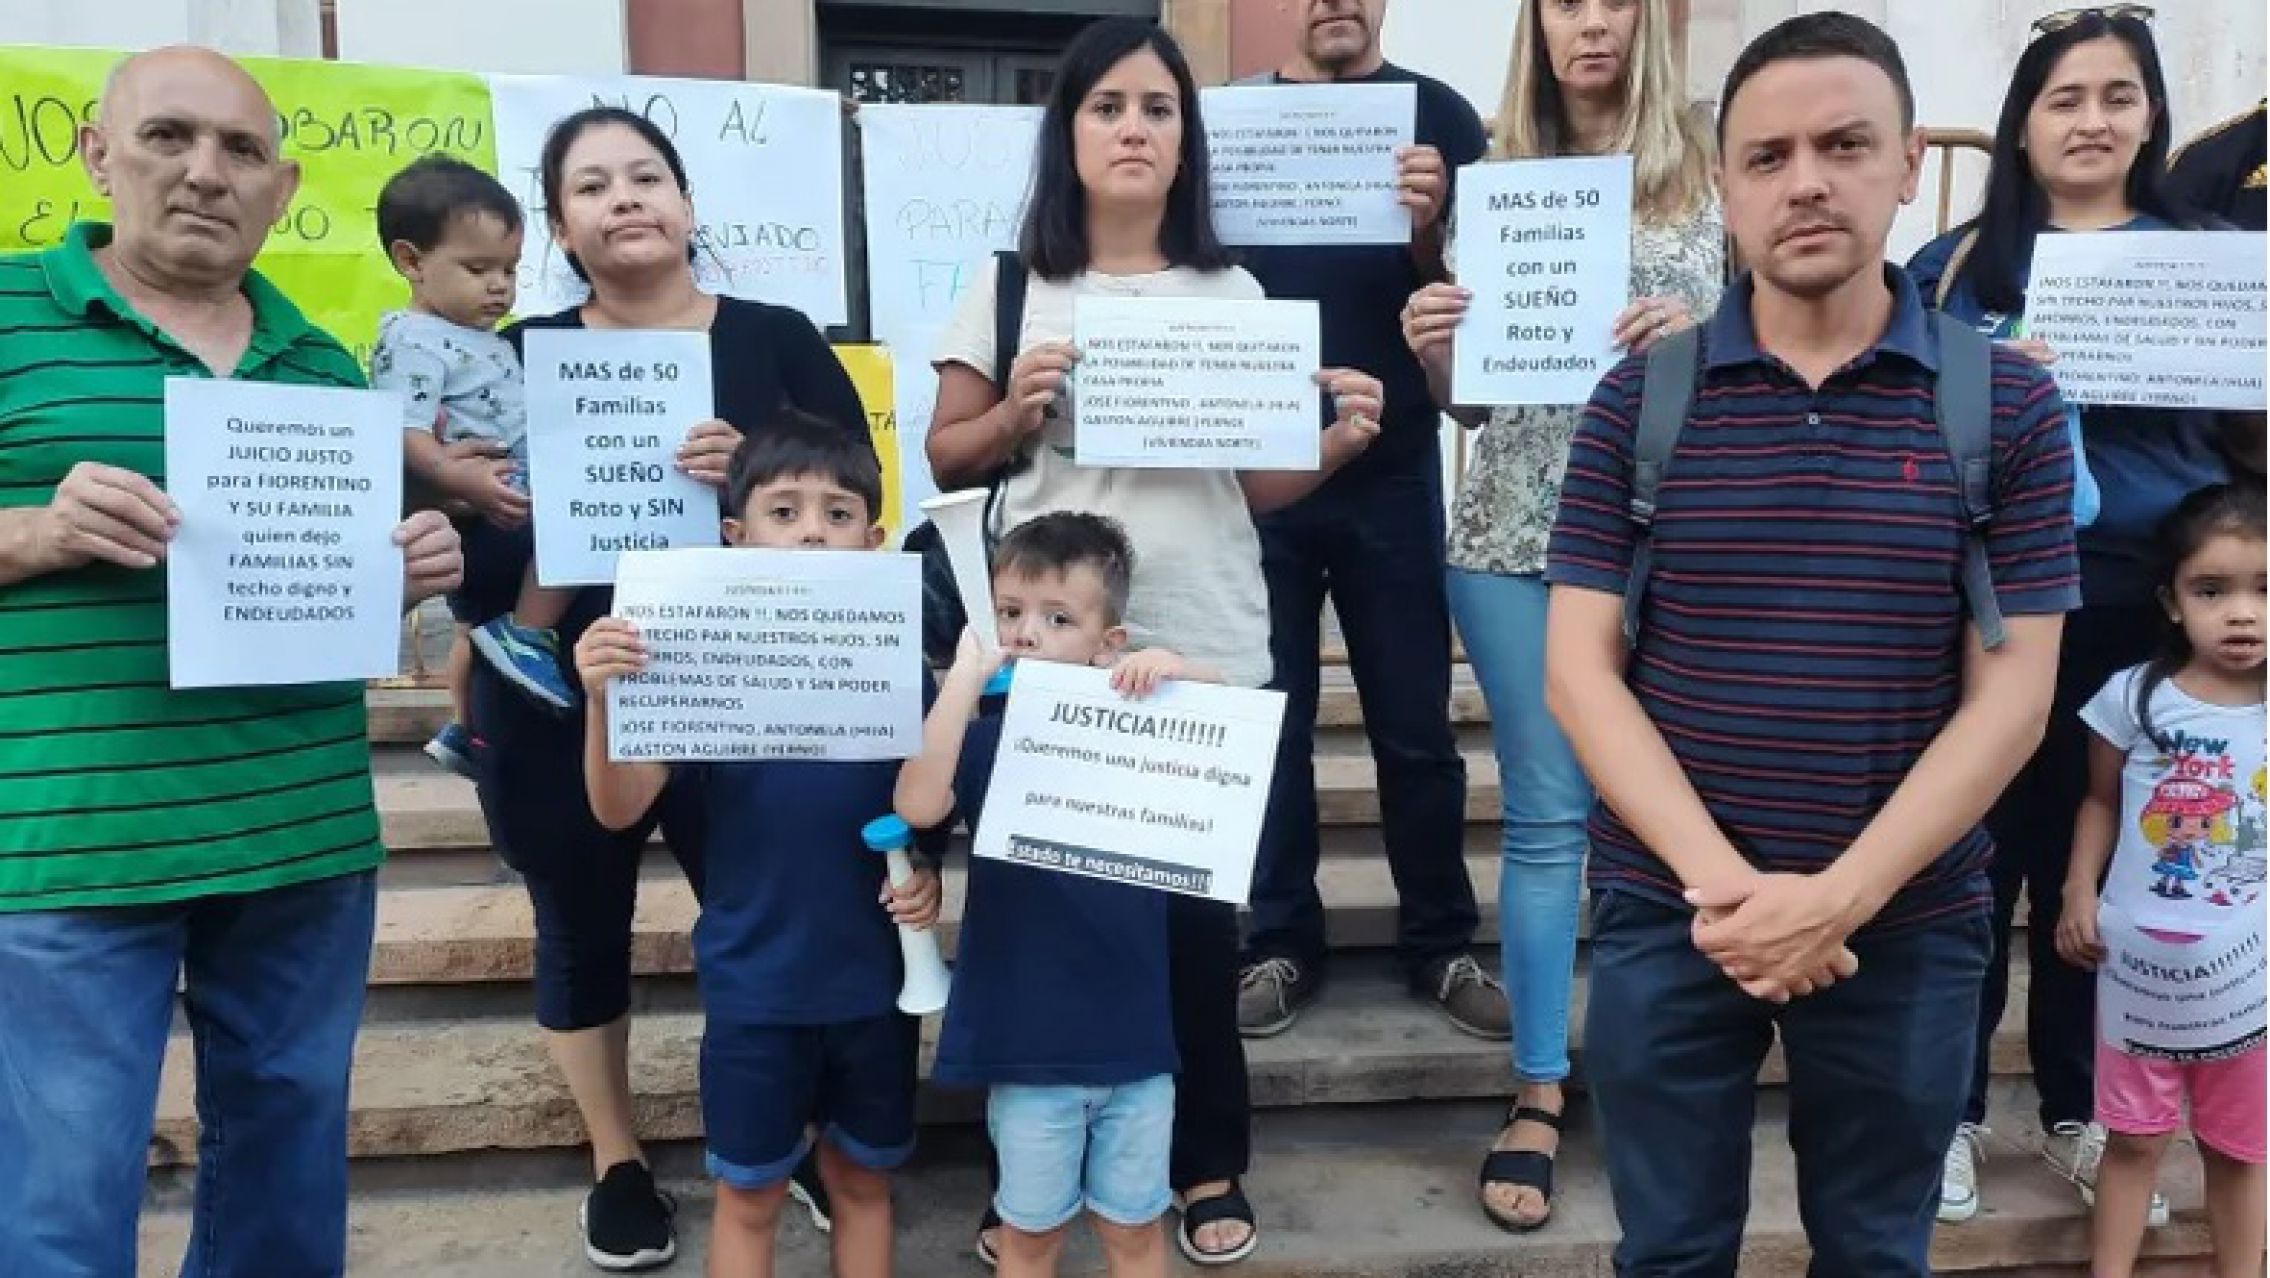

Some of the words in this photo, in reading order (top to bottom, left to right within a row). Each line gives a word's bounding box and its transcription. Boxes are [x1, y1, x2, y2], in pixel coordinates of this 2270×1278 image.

[1488, 190, 1536, 211] MAS
[1541, 190, 1568, 208] de
[1575, 188, 1600, 207] 50
[896, 197, 1012, 241] PARA
[1500, 222, 1585, 243] Familias
[1506, 262, 1544, 277] con
[1550, 261, 1577, 275] un
[1504, 285, 1577, 309] SUEÑO
[1506, 325, 1556, 341] Roto
[1562, 327, 1573, 343] y
[559, 361, 612, 381] MAS
[619, 361, 645, 381] de
[653, 362, 679, 381] 50
[1483, 355, 1597, 372] Endeudados
[575, 395, 666, 415] Familias
[227, 417, 326, 437] Queremos
[328, 426, 355, 437] un
[585, 435, 625, 448] con
[633, 435, 660, 448] un
[227, 446, 291, 462] JUICIO
[296, 449, 353, 465] JUSTO
[585, 461, 664, 483] SUEÑO
[207, 476, 251, 490] para
[258, 474, 372, 492] FIORENTINO
[229, 500, 240, 514] Y
[246, 501, 272, 516] SU
[278, 501, 353, 517] FAMILIA
[570, 499, 623, 517] Roto
[628, 503, 643, 520] y
[648, 498, 684, 517] SIN
[242, 529, 297, 544] quien
[300, 529, 341, 546] dejo
[590, 533, 669, 551] Justicia
[229, 554, 318, 569] FAMILIAS
[323, 555, 353, 569] SIN
[228, 581, 283, 595] techo
[287, 581, 337, 599] digno
[342, 586, 351, 597] y
[224, 605, 355, 621] ENDEUDADOS
[659, 605, 750, 620] ESTAFARON
[776, 609, 808, 621] NOS
[812, 609, 906, 624] QUEDAMOS
[645, 629, 697, 642] TECHO
[702, 629, 733, 642] PAR
[737, 631, 818, 645] NUESTROS
[875, 635, 900, 647] SIN
[818, 657, 853, 670] CON
[620, 672, 714, 686] PROBLEMAS
[717, 674, 736, 687] DE
[742, 675, 794, 690] SALUD
[797, 678, 806, 690] Y
[811, 678, 834, 690] SIN
[837, 679, 891, 692] PODER
[619, 696, 744, 710] RECUPERARNOS
[622, 721, 655, 734] JOSE
[1049, 702, 1228, 748] JUSTICIA!!!!!!!
[619, 744, 686, 757] GASTON
[691, 744, 758, 757] AGUIRRE
[1105, 752, 1136, 770] una
[1139, 756, 1199, 779] justicia
[1203, 767, 1251, 788] digna
[2174, 754, 2236, 779] York
[1025, 792, 1061, 807] para
[1065, 797, 1135, 821] nuestras
[1140, 807, 1213, 834] familias!
[1065, 852, 1081, 868] te
